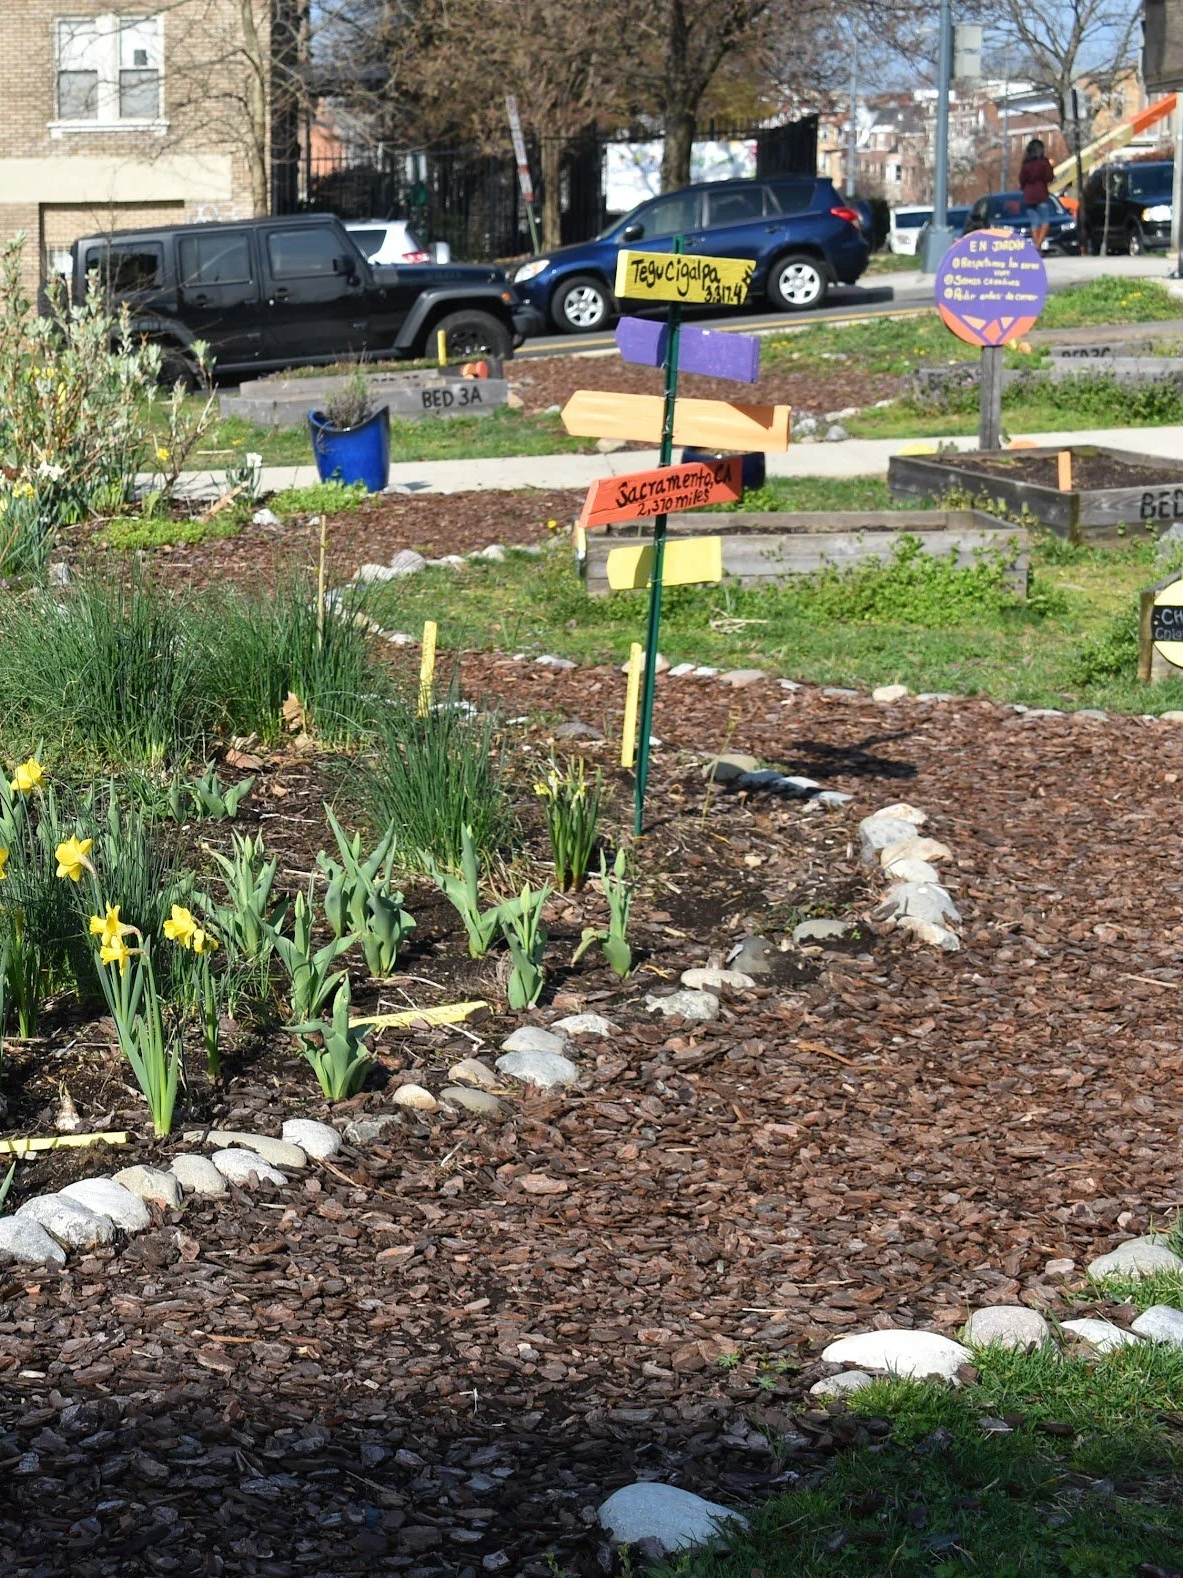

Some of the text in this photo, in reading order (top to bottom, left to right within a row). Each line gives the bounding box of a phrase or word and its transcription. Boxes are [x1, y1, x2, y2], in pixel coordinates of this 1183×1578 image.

[422, 386, 482, 408] BED 3A
[675, 489, 710, 508] miles
